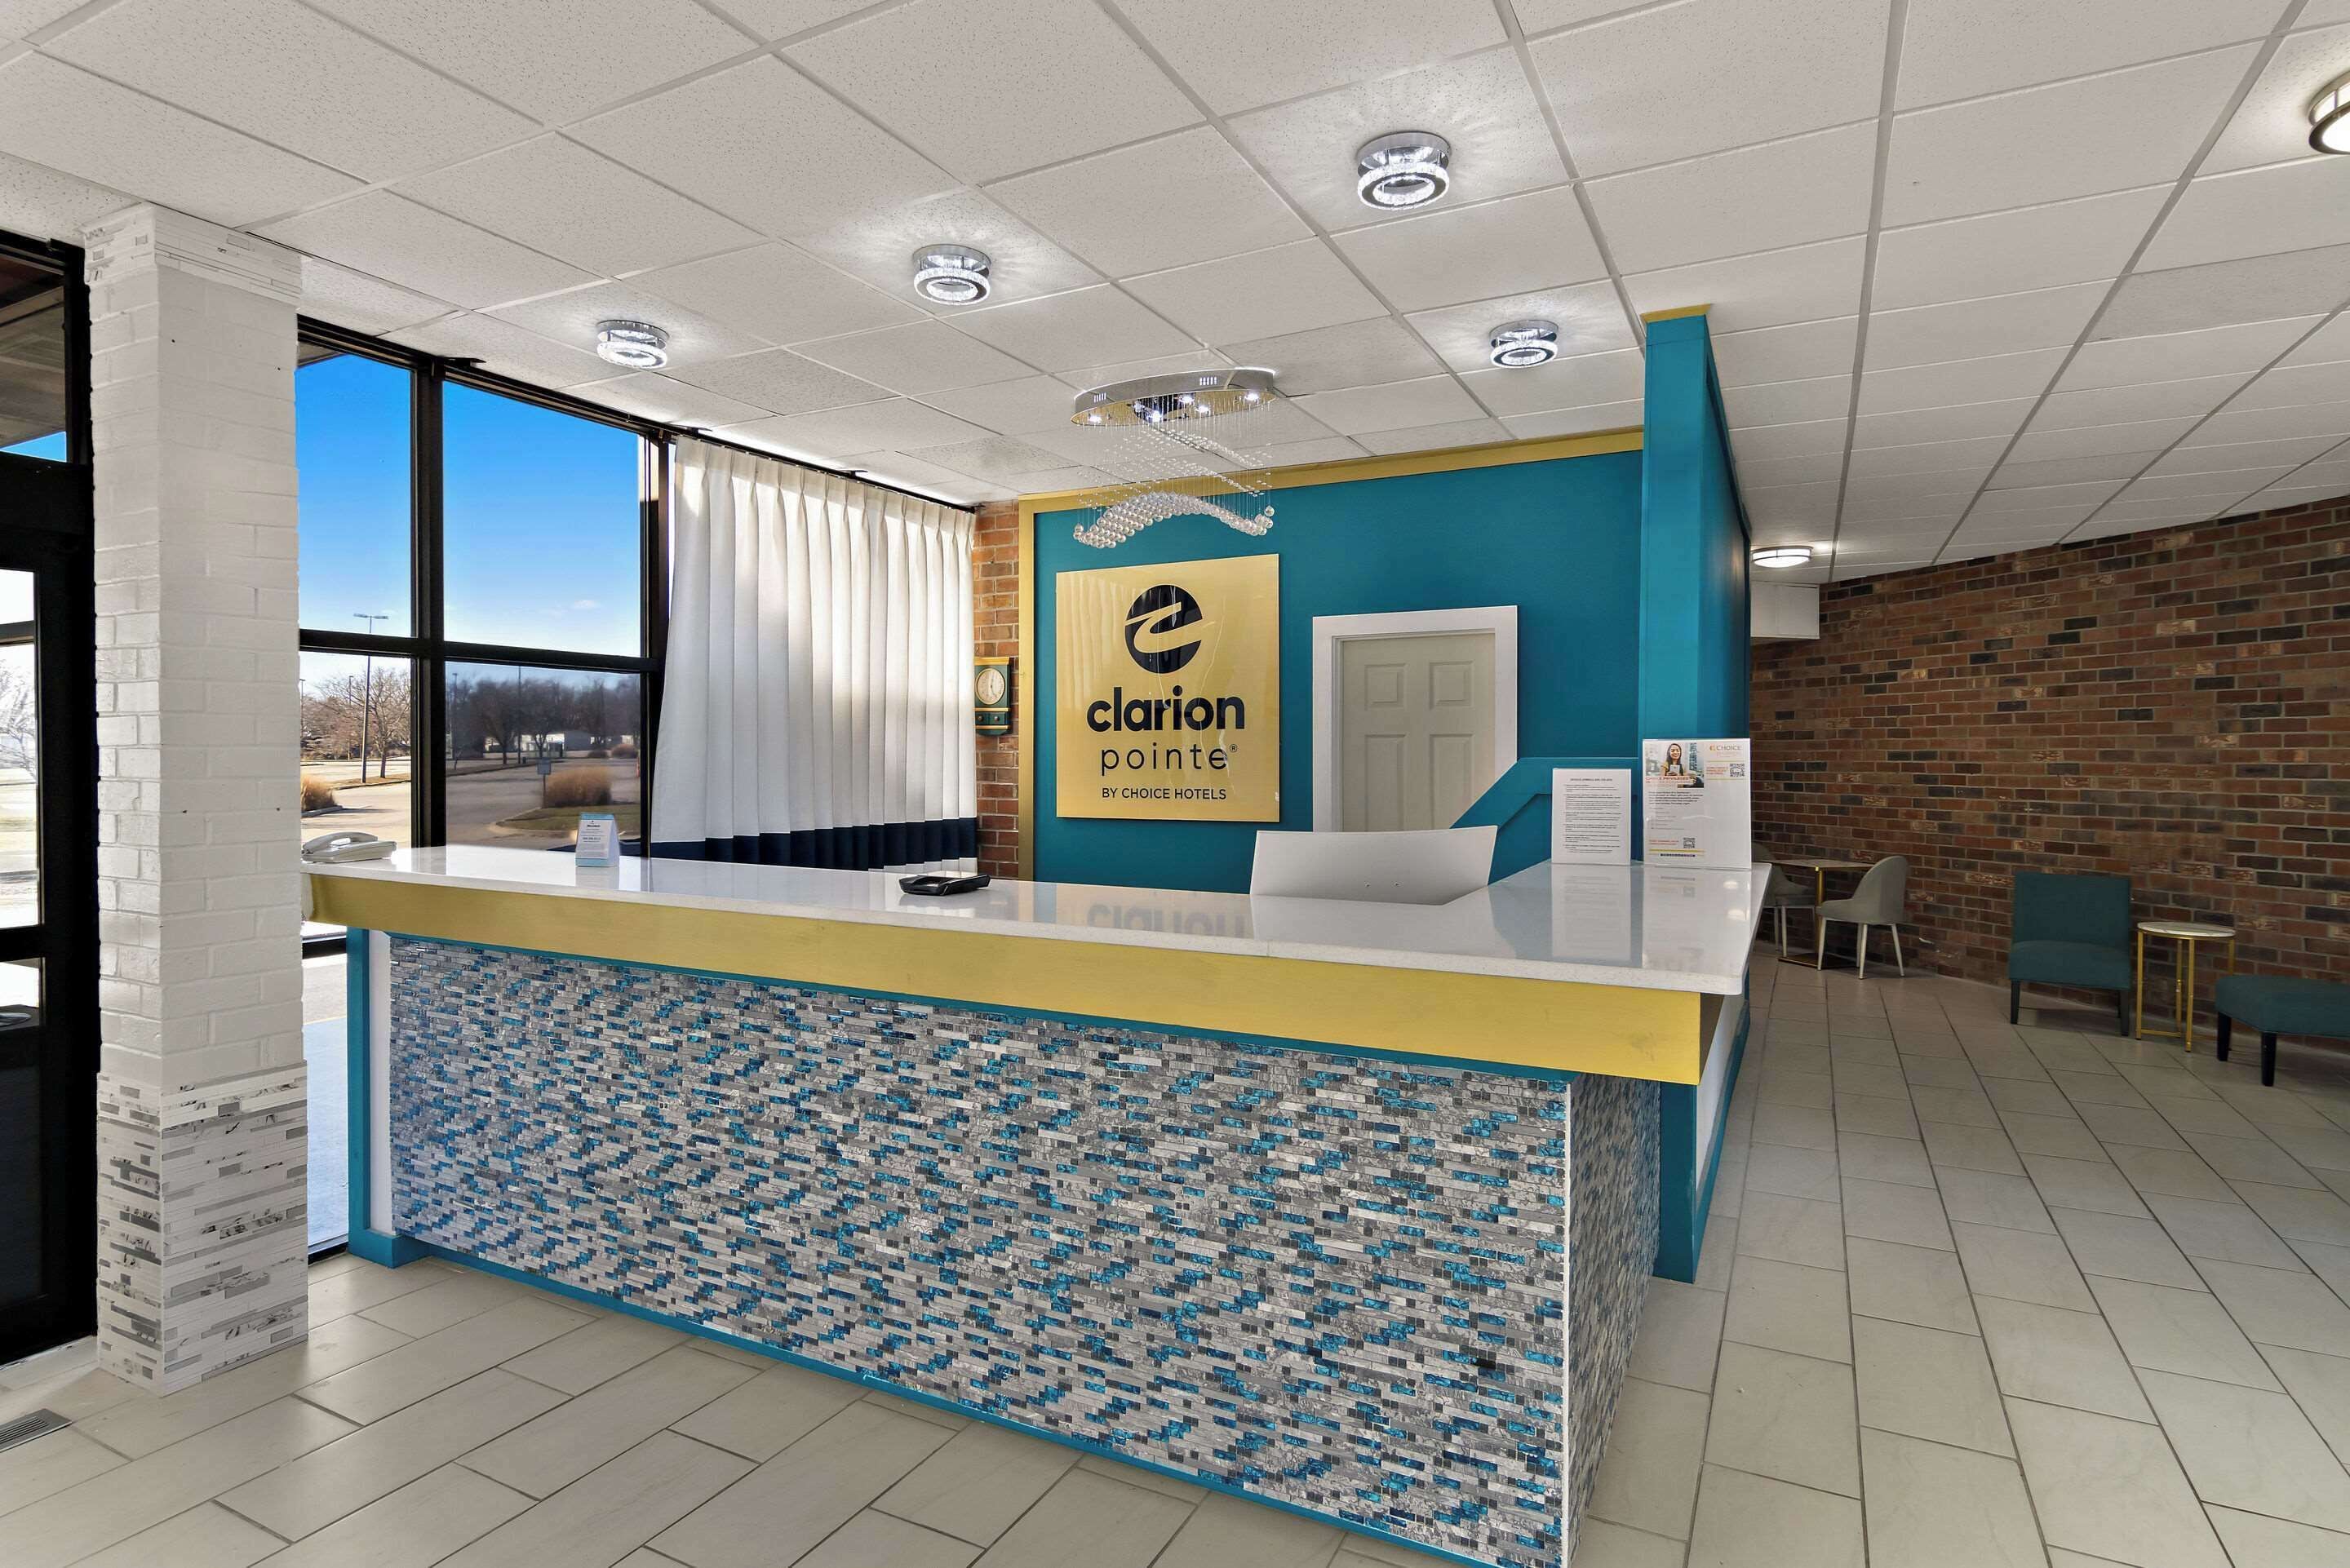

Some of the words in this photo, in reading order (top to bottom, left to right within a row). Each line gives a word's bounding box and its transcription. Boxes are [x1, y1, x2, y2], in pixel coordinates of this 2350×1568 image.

[1087, 685, 1245, 733] clarion
[1102, 787, 1118, 799] BY
[1121, 788, 1170, 800] CHOICE
[1174, 788, 1226, 800] HOTELS
